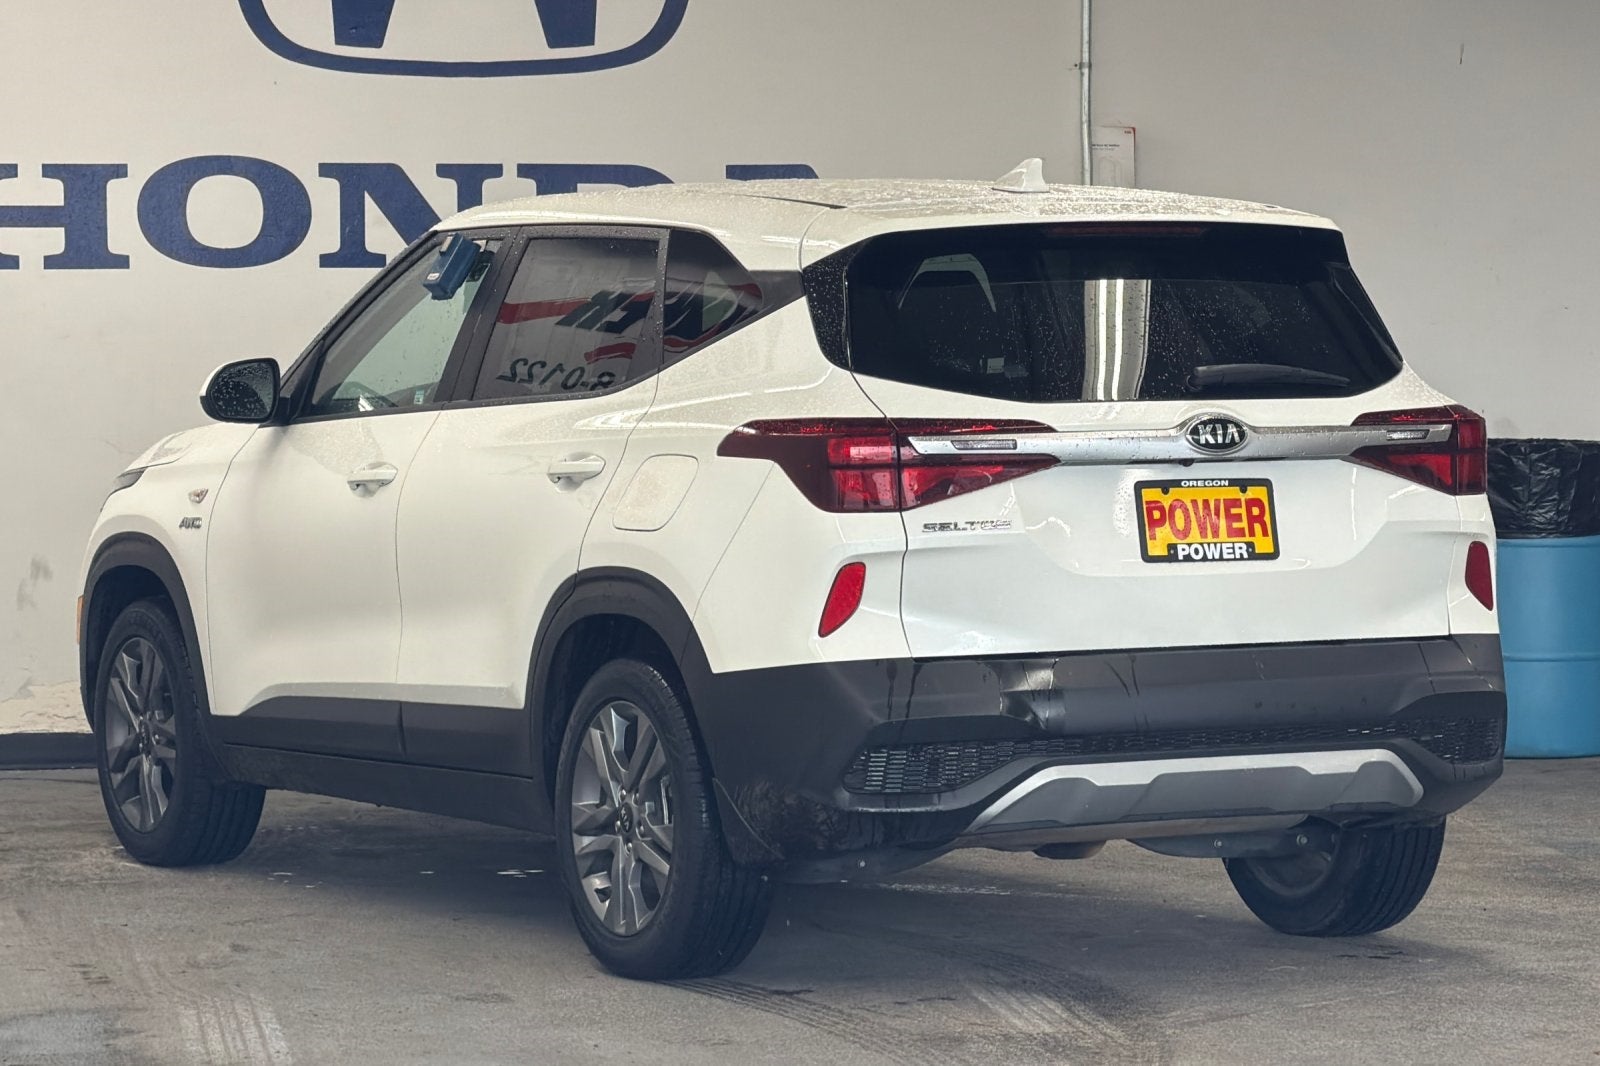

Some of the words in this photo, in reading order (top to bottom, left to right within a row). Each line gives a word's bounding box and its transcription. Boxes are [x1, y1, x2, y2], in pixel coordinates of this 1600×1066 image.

[1197, 423, 1242, 445] KIA
[1180, 480, 1229, 488] OREGON
[922, 519, 1012, 533] SELTOS
[1145, 497, 1270, 541] POWER
[1177, 542, 1249, 560] POWER
